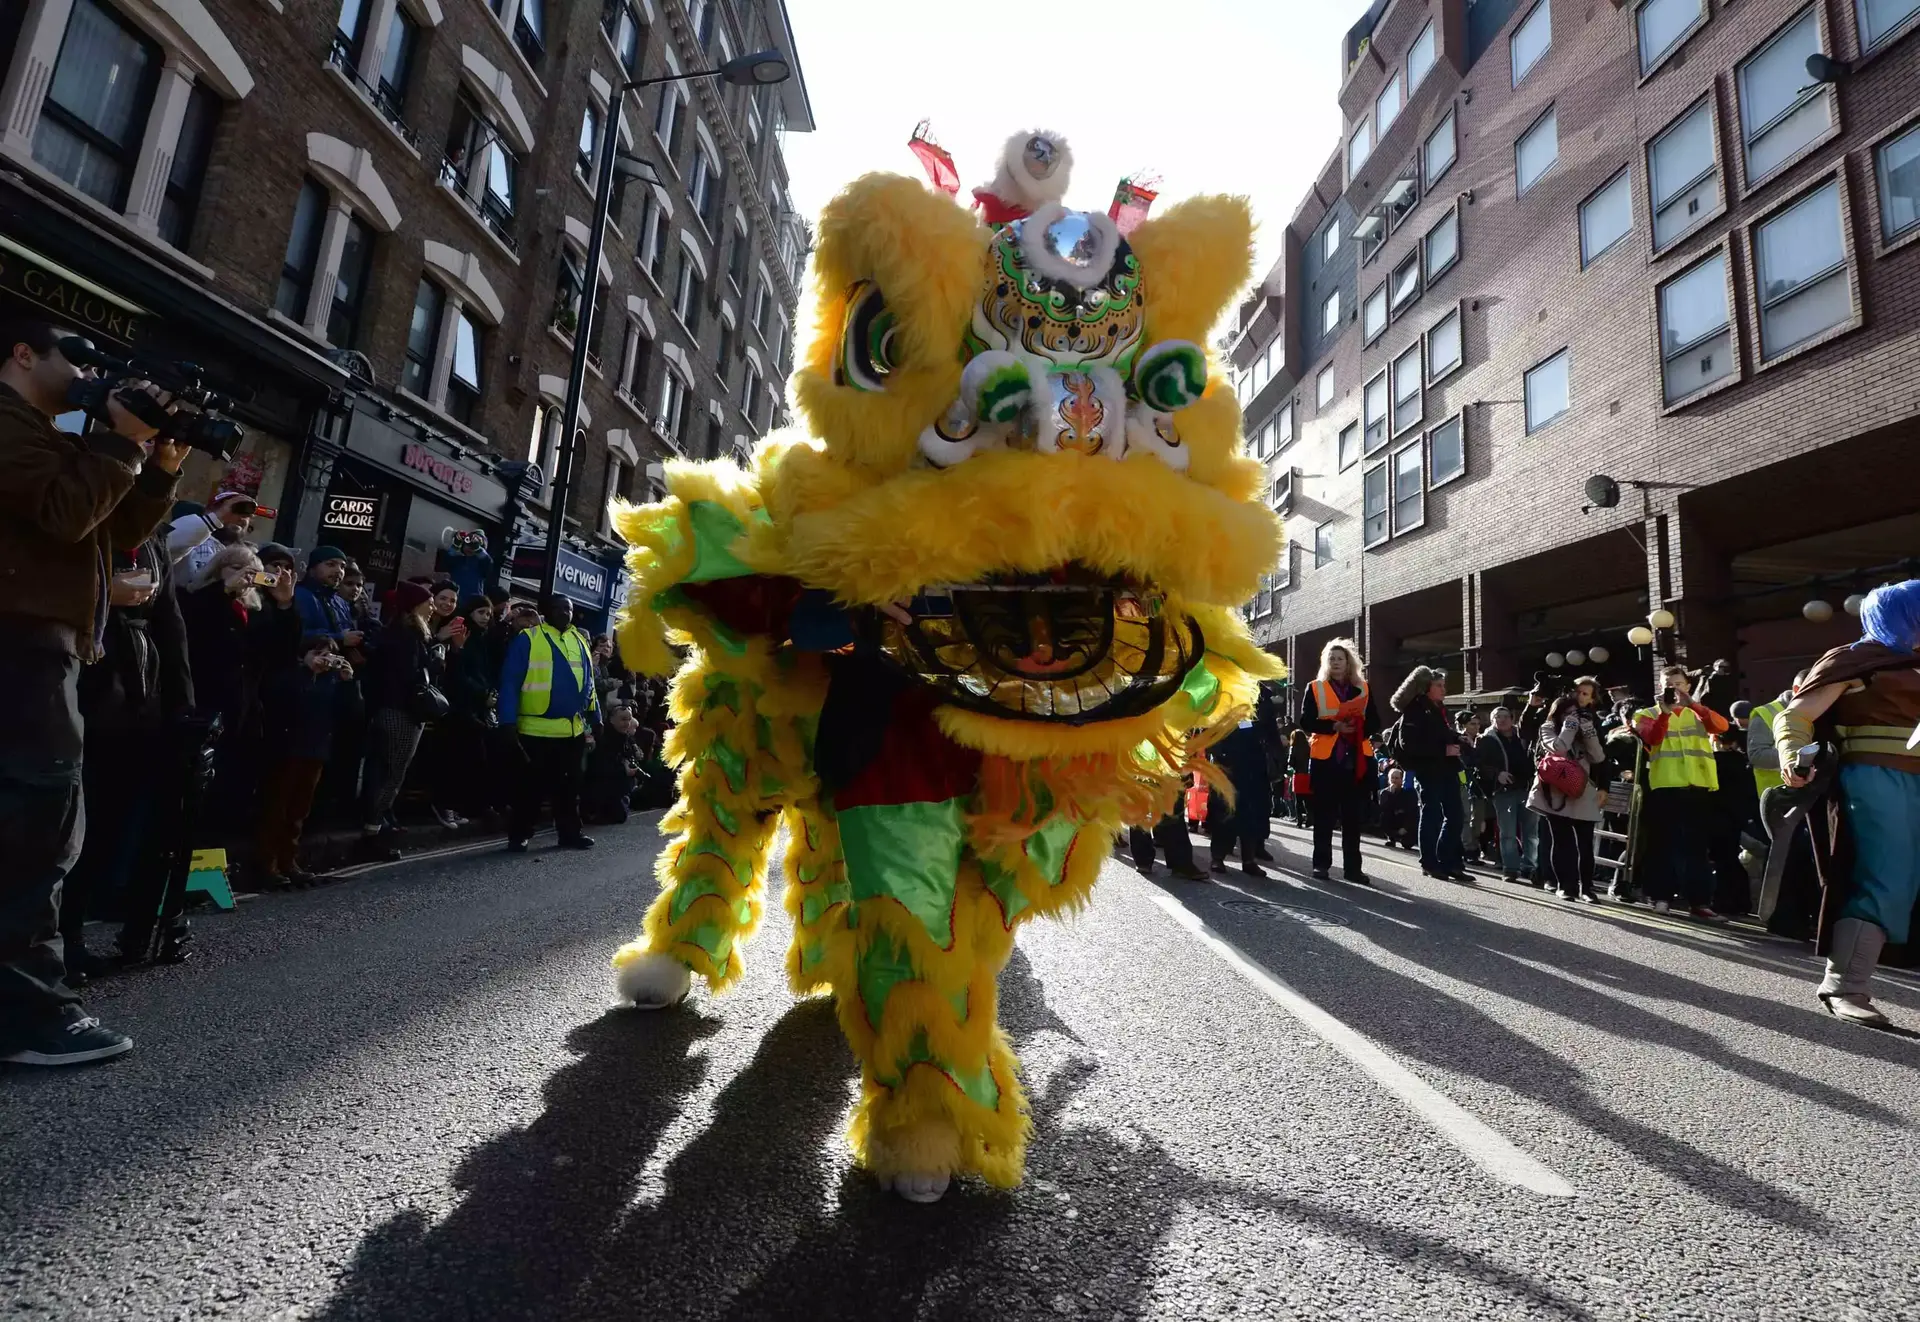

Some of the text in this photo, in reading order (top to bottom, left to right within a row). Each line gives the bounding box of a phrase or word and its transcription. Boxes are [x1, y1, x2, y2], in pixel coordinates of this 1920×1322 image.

[23, 269, 140, 341] GALORE
[330, 499, 374, 514] CARDS
[324, 512, 375, 528] GALORE
[557, 561, 603, 593] verwell
